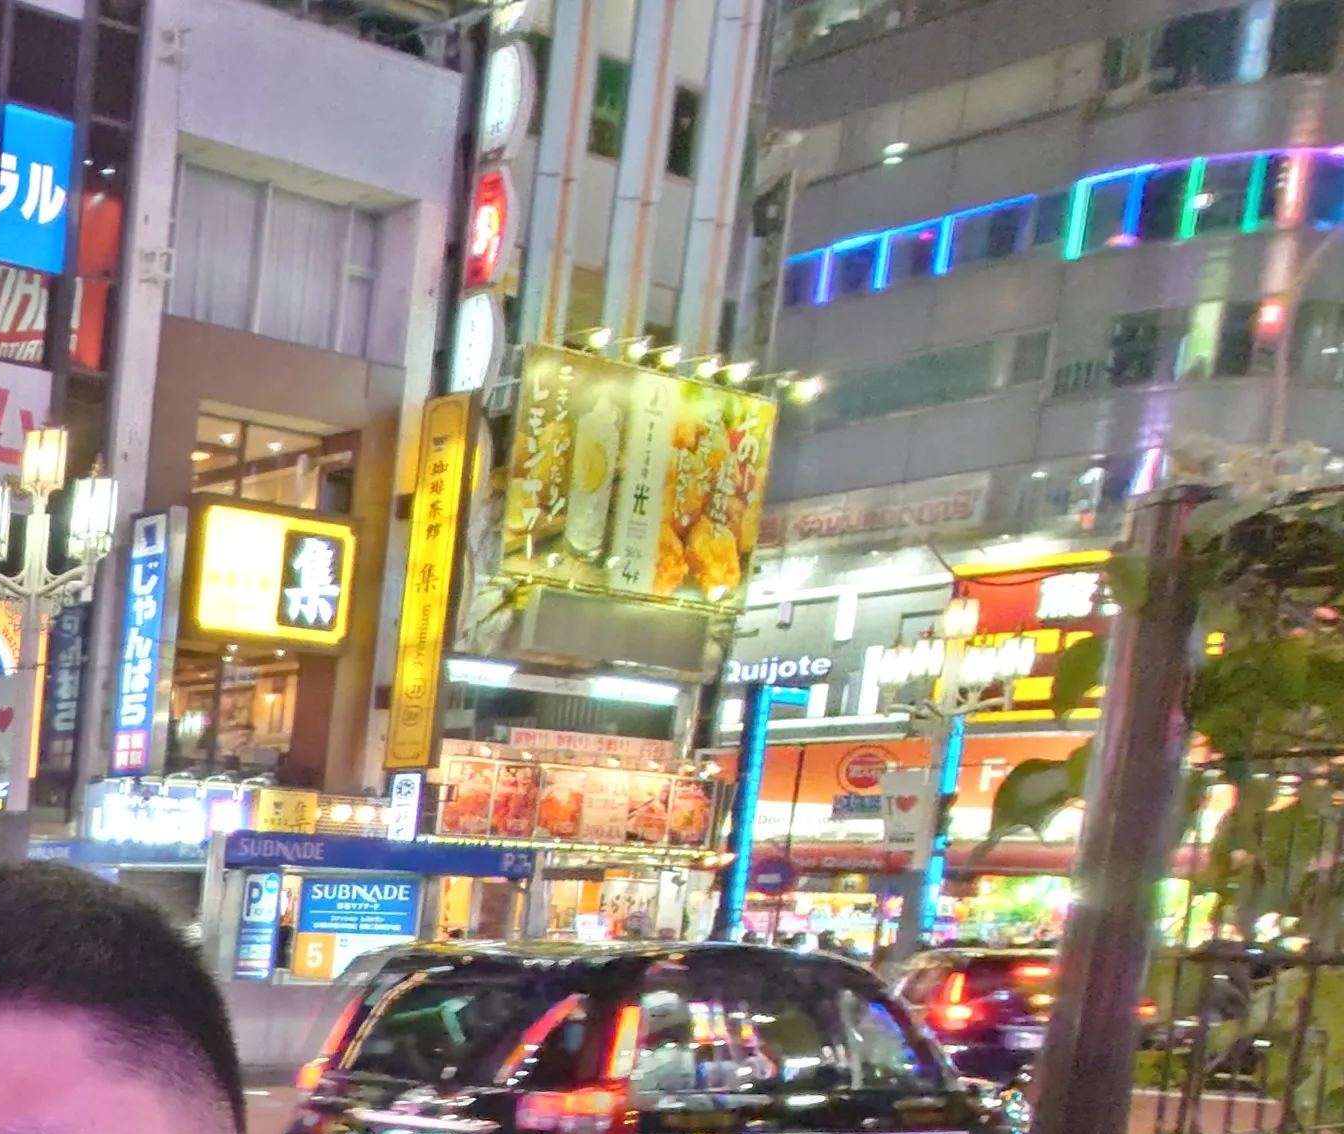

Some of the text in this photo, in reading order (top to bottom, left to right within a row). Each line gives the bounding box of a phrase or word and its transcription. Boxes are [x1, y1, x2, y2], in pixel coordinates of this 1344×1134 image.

[521, 376, 550, 560] レモンサワー
[284, 537, 341, 625] 集
[727, 654, 833, 685] Quijote
[238, 838, 325, 861] SUBNADE
[312, 883, 412, 903] SUBNADE
[306, 942, 323, 968] 5
